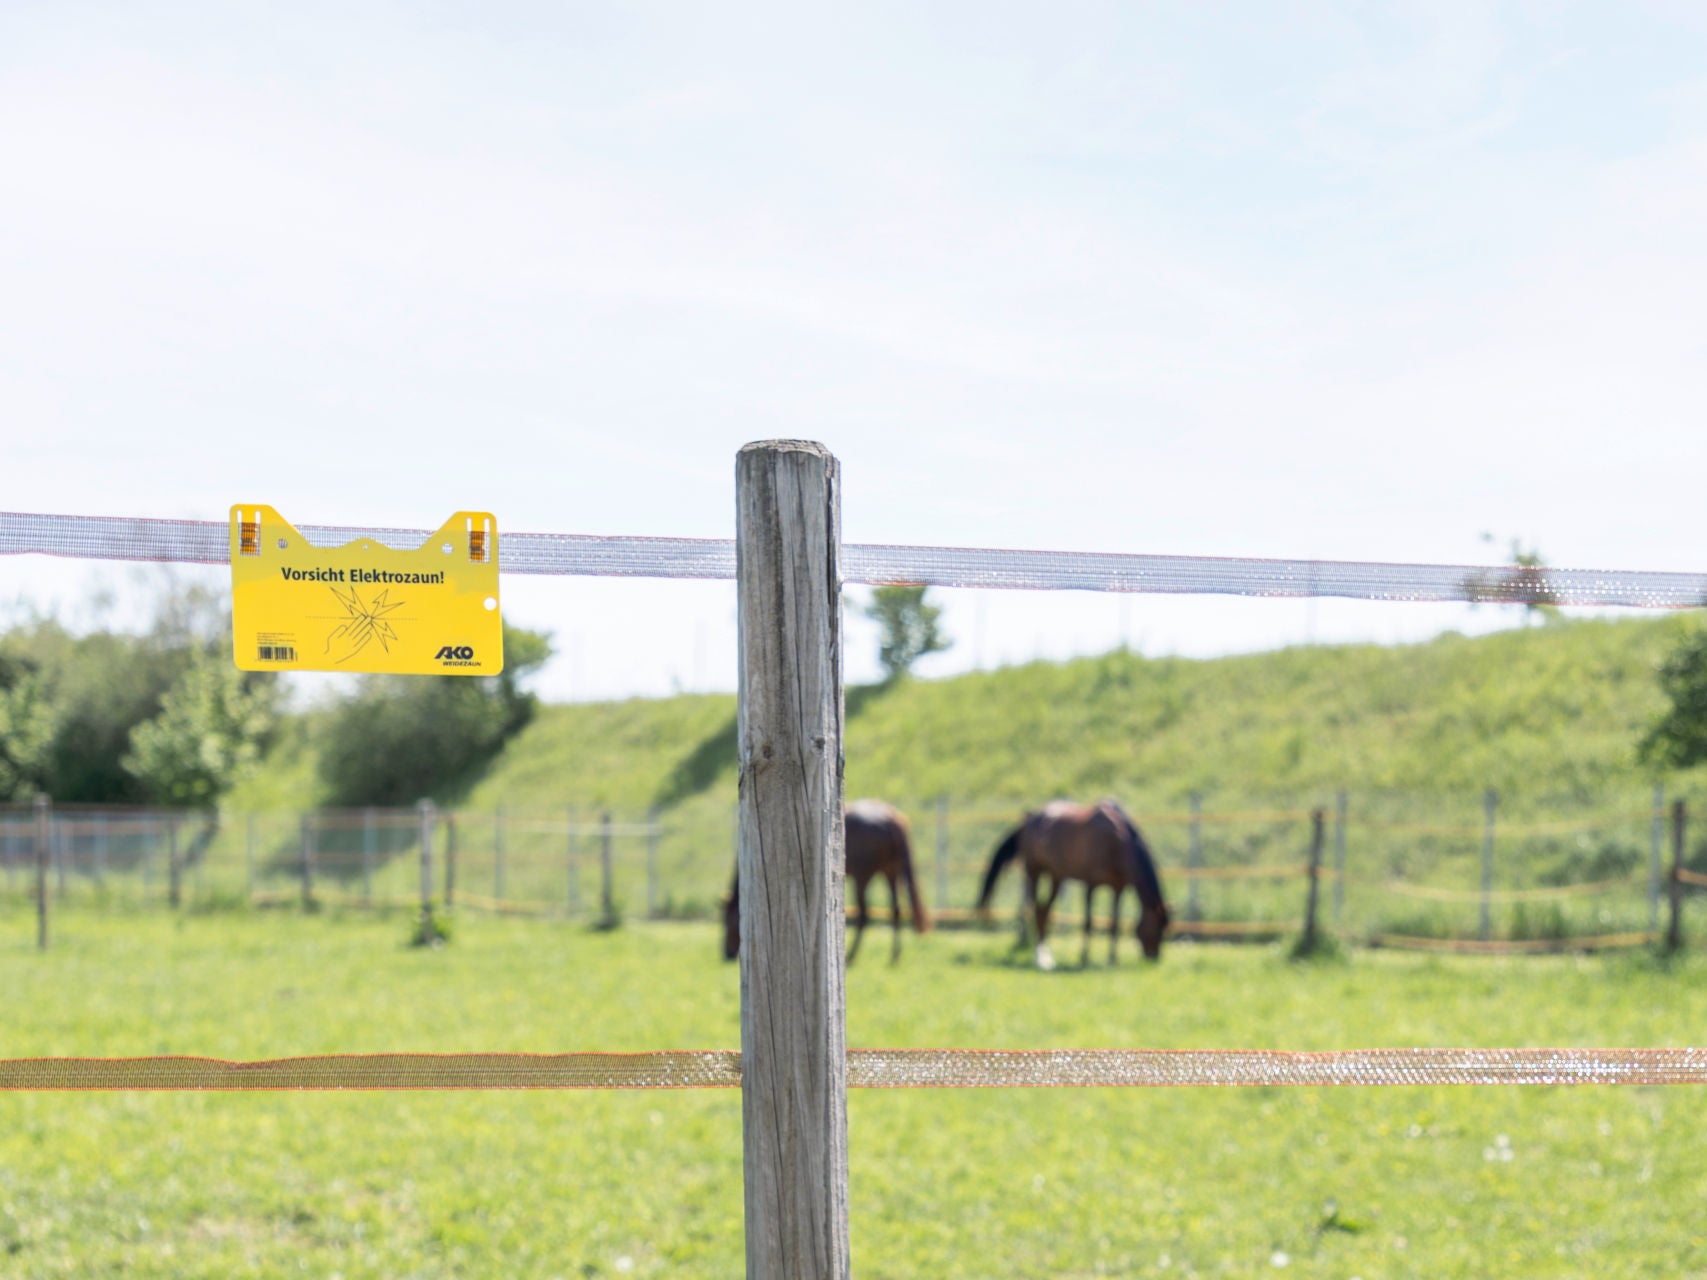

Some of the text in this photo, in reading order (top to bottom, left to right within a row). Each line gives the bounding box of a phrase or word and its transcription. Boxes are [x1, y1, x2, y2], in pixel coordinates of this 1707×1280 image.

[281, 567, 444, 584] Vorsicht Elektrozaun!
[434, 646, 474, 660] AKO
